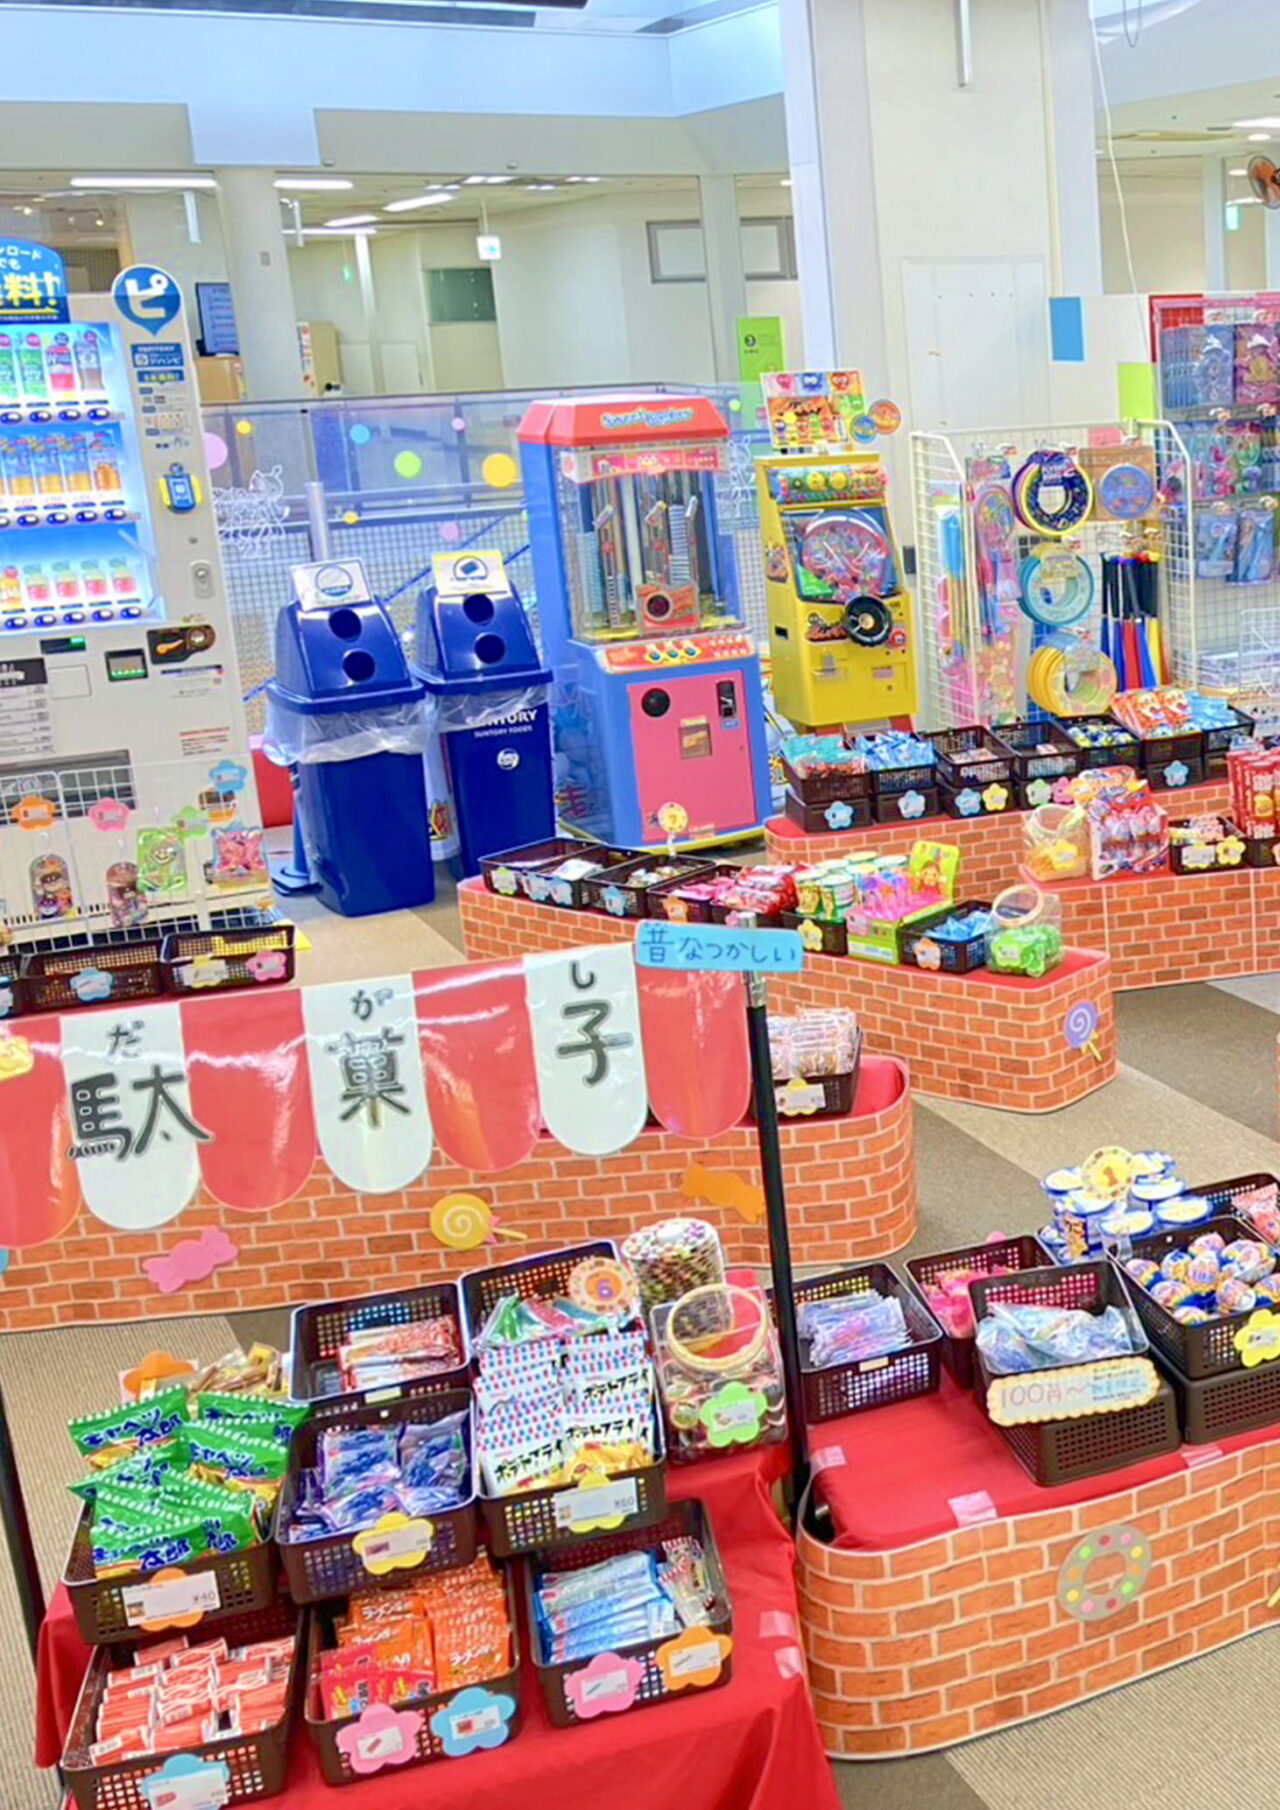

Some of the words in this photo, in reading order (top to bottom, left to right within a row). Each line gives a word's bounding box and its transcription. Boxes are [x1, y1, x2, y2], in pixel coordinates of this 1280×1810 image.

[125, 274, 169, 319] ピ
[640, 923, 797, 964] 昔なつかしい
